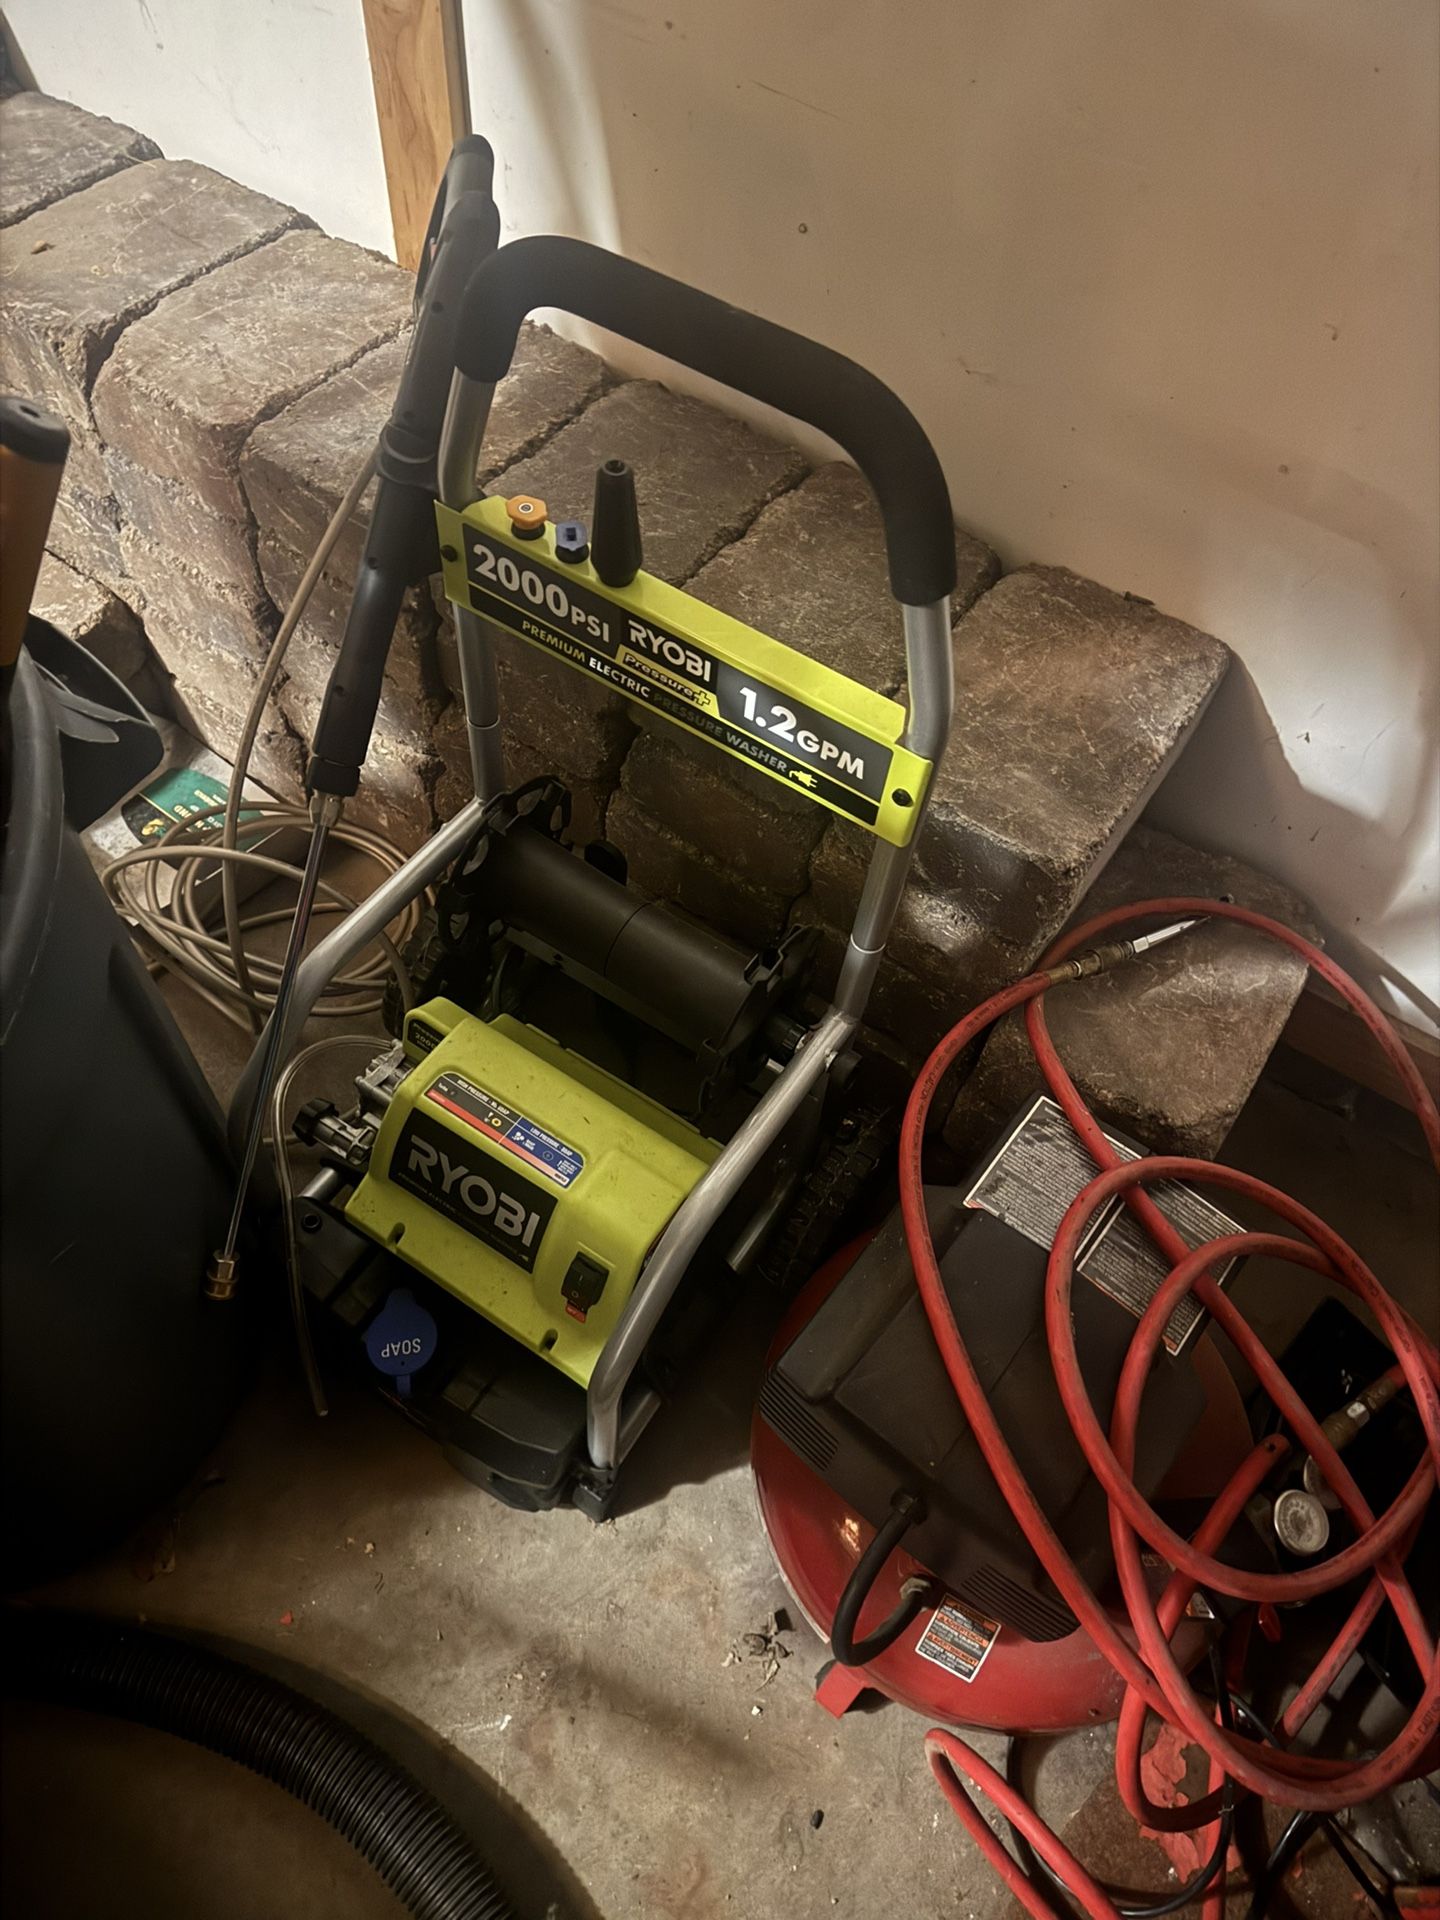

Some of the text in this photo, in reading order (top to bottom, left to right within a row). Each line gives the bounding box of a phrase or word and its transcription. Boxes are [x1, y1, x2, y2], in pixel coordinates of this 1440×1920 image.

[628, 619, 711, 682] RYOBI
[522, 620, 788, 773] PREMIUM ELECTRIC PRESSURE WASHER
[408, 1134, 540, 1248] RYOBI
[381, 1338, 421, 1359] SOAP
